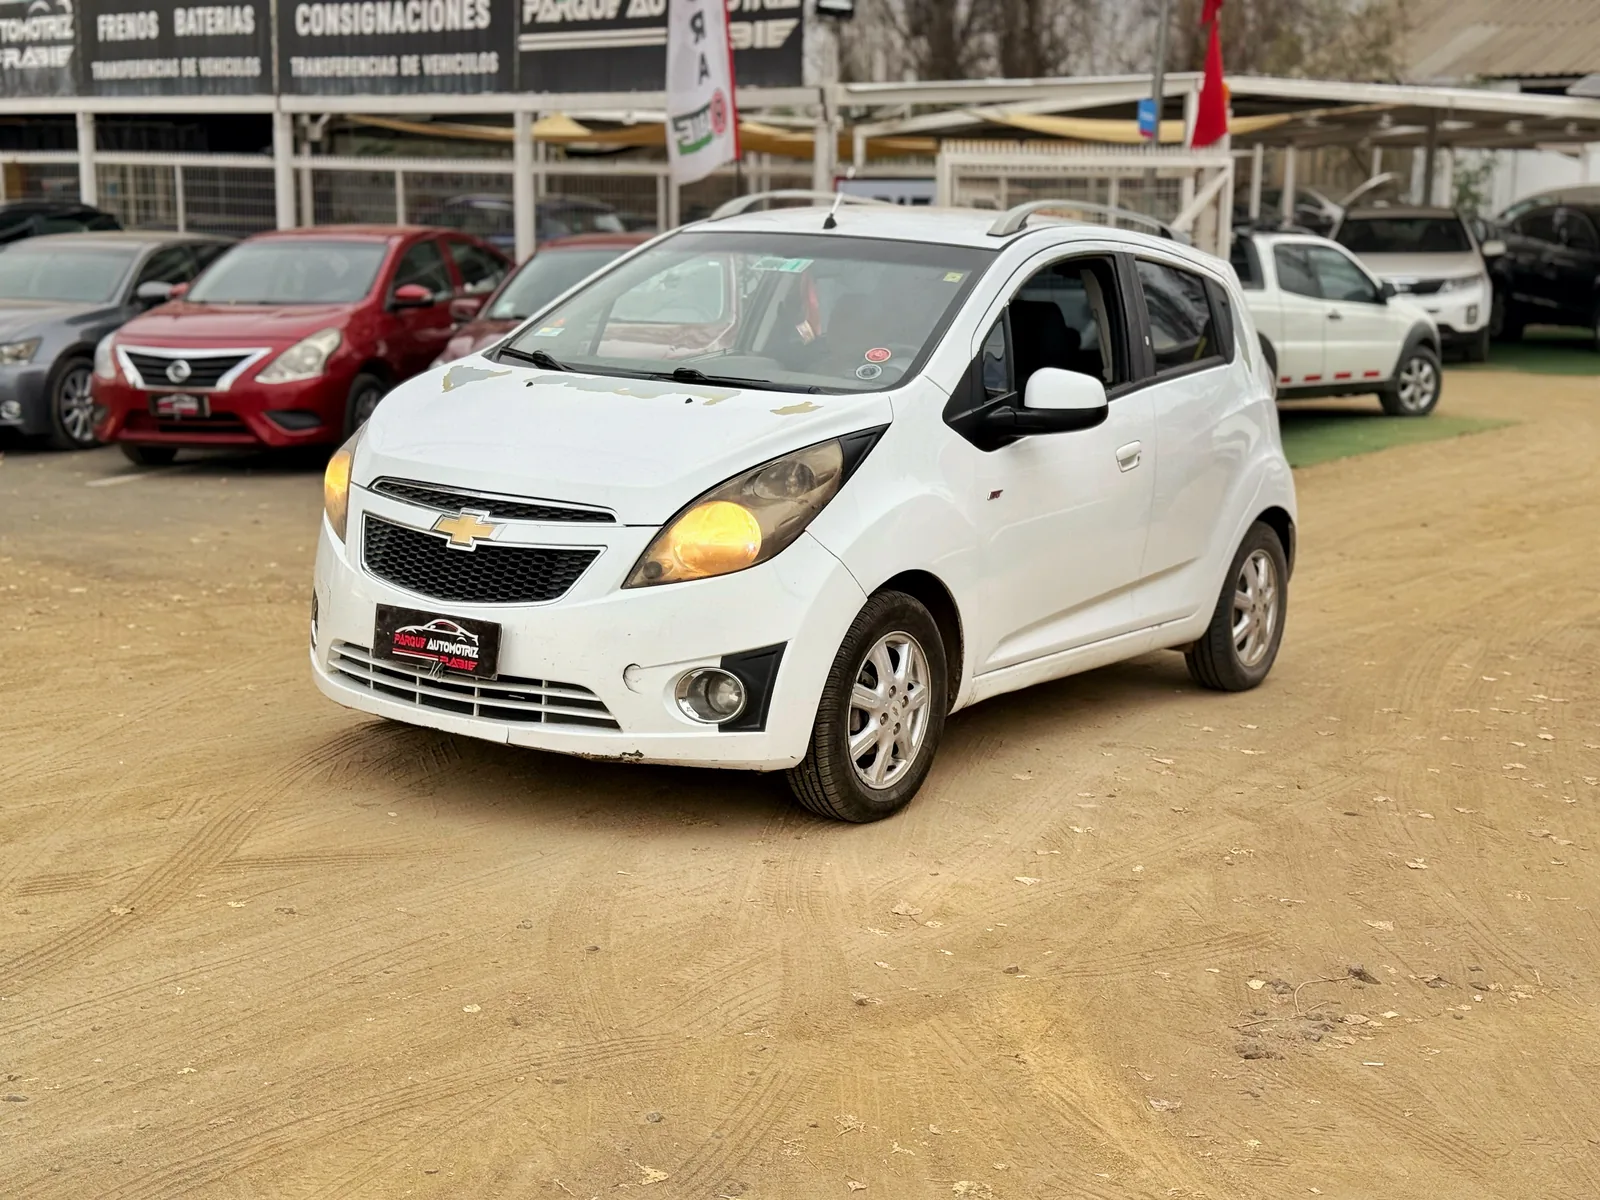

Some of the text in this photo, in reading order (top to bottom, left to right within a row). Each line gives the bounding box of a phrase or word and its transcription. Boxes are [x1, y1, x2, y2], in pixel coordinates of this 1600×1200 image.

[97, 5, 255, 42] FRENOS BATERIAS
[295, 0, 491, 36] CONSIGNACIONES
[181, 57, 197, 77] DE
[400, 54, 420, 76] DE
[422, 51, 499, 76] VEHICULOS
[427, 638, 479, 659] AUTOMOTRIZ
